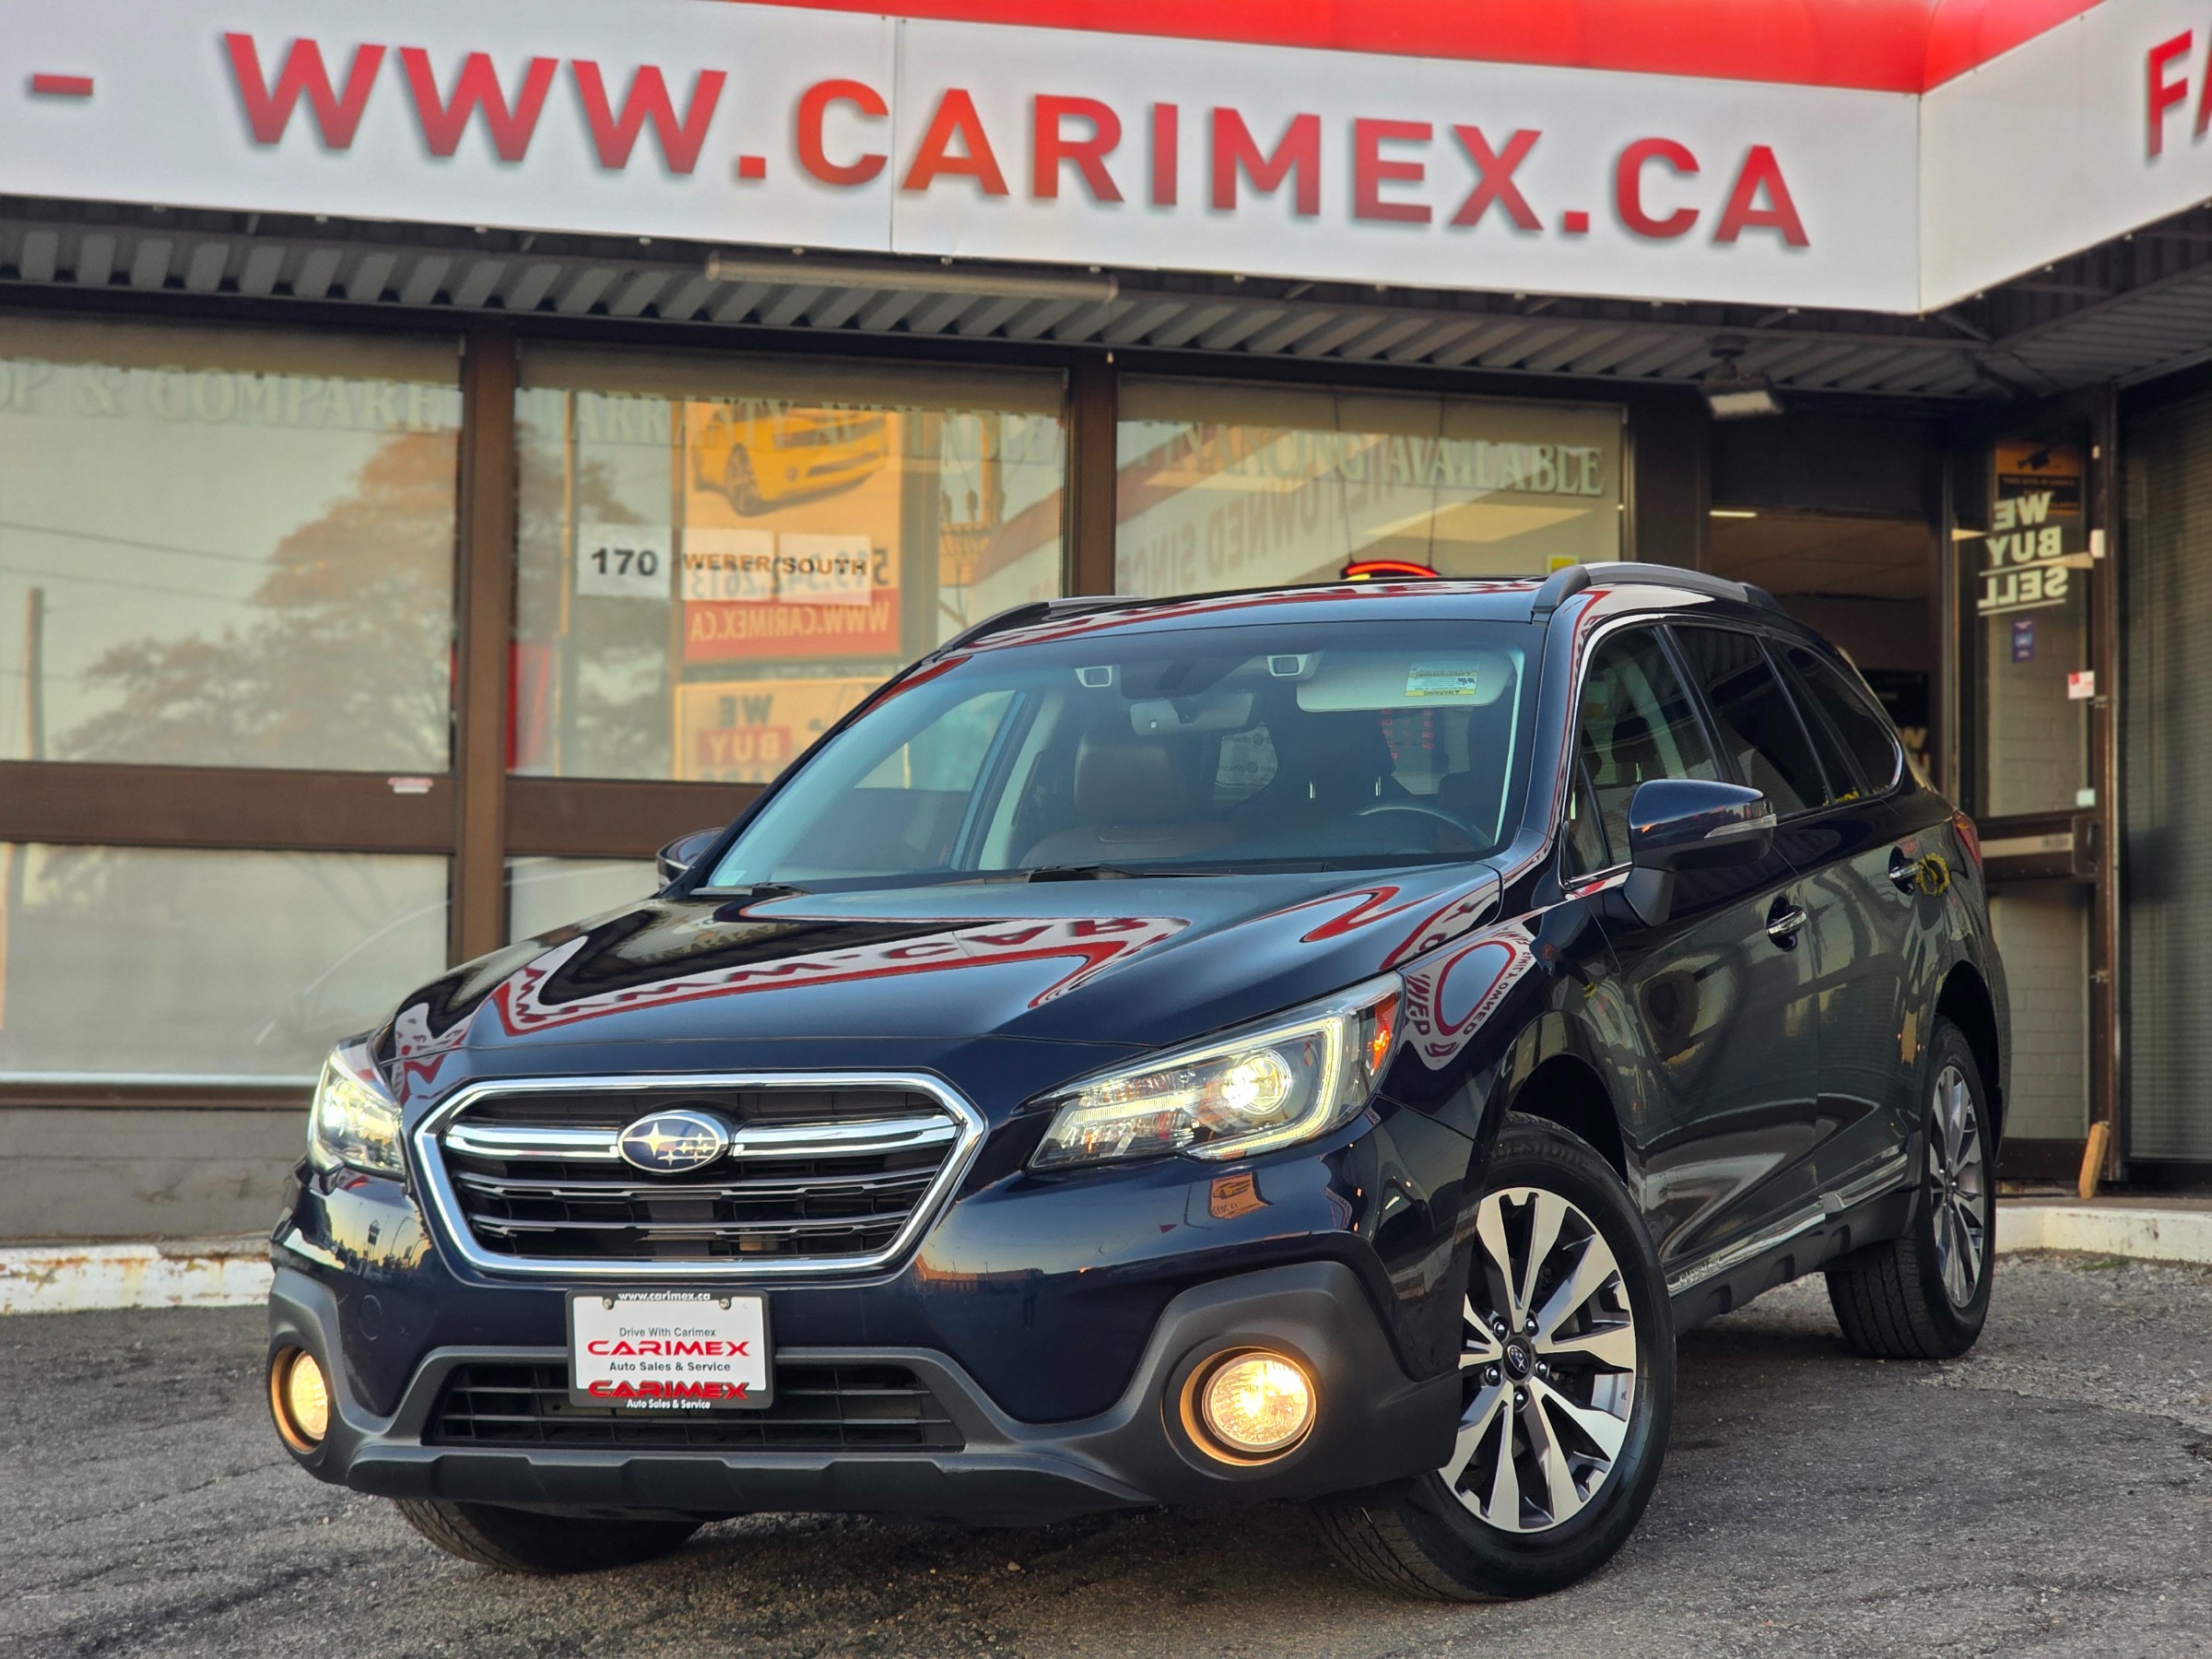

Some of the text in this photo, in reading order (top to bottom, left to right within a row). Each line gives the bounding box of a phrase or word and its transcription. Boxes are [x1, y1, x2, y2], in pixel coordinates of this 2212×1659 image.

[224, 32, 1810, 247] WWW.CARIMEX.CA
[147, 365, 441, 431] COMPARE
[1388, 433, 1605, 497] AVAILABLE
[591, 547, 867, 576] 170 WEBER SOUTH
[618, 1290, 711, 1301] www.carimex.ca
[619, 1327, 716, 1337] Drive With Carimex
[587, 1340, 750, 1357] CARIMEX
[609, 1361, 731, 1371] Auto Sales & Service
[587, 1380, 750, 1400] CARIMEX
[627, 1399, 711, 1409] Auto Sales & Service
